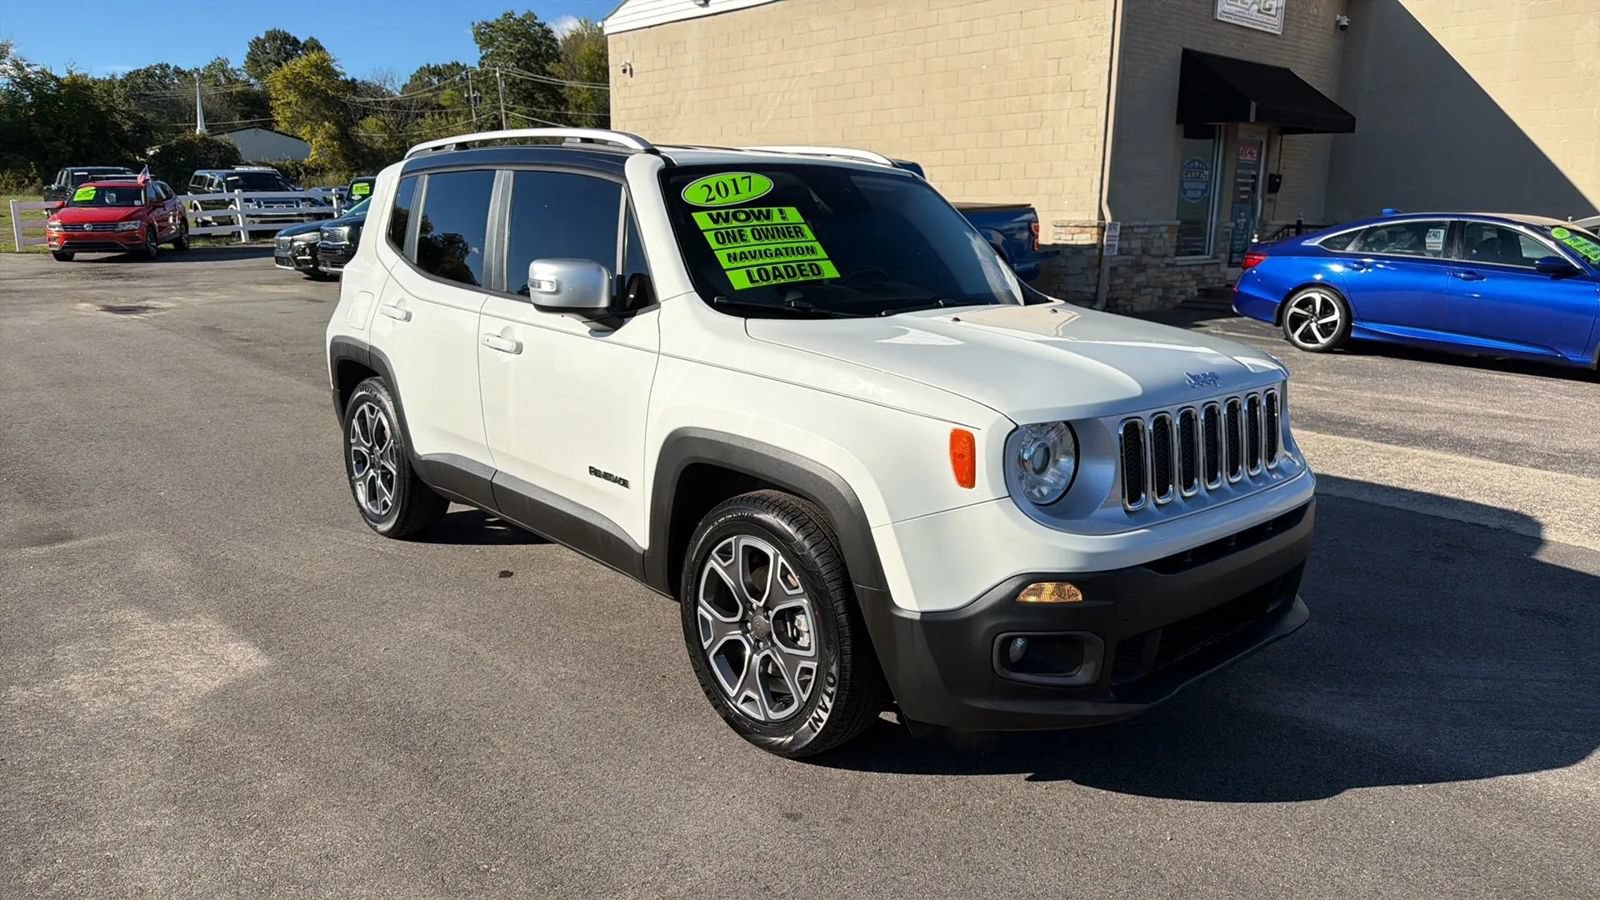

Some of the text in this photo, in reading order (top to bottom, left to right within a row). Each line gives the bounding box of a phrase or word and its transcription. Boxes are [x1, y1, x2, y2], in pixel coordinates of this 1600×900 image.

[701, 175, 752, 203] 2017
[714, 225, 807, 245] ONE OWNER
[726, 245, 817, 264] NAVIGATION
[745, 262, 825, 286] LOADED
[1183, 371, 1221, 388] Jeep
[588, 465, 630, 489] RENEGADE
[807, 671, 837, 733] OTANI
